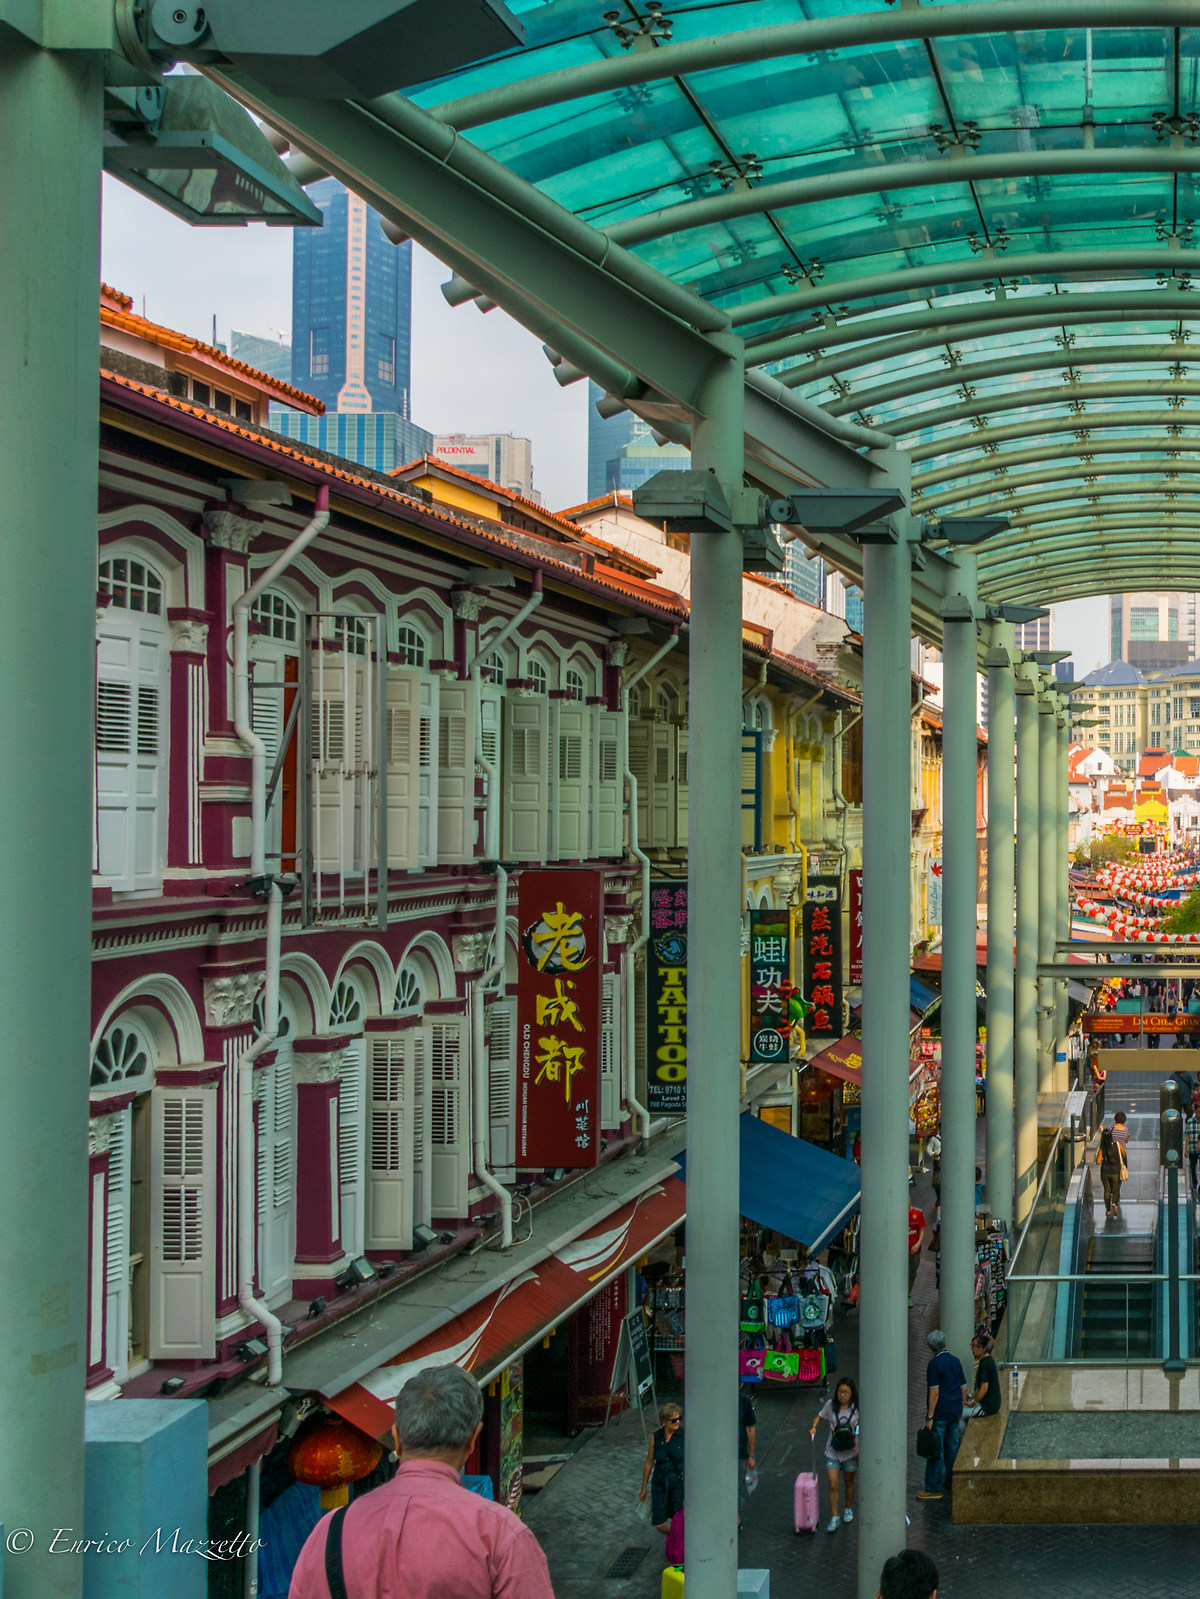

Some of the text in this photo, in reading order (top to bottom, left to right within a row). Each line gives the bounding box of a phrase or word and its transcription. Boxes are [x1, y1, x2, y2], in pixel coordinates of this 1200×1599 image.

[656, 967, 687, 1082] TATTOO
[1132, 1017, 1148, 1025] LIM
[1175, 1017, 1199, 1025] GUAN
[522, 1041, 530, 1079] CHENGDU
[650, 1085, 663, 1094] TEL:
